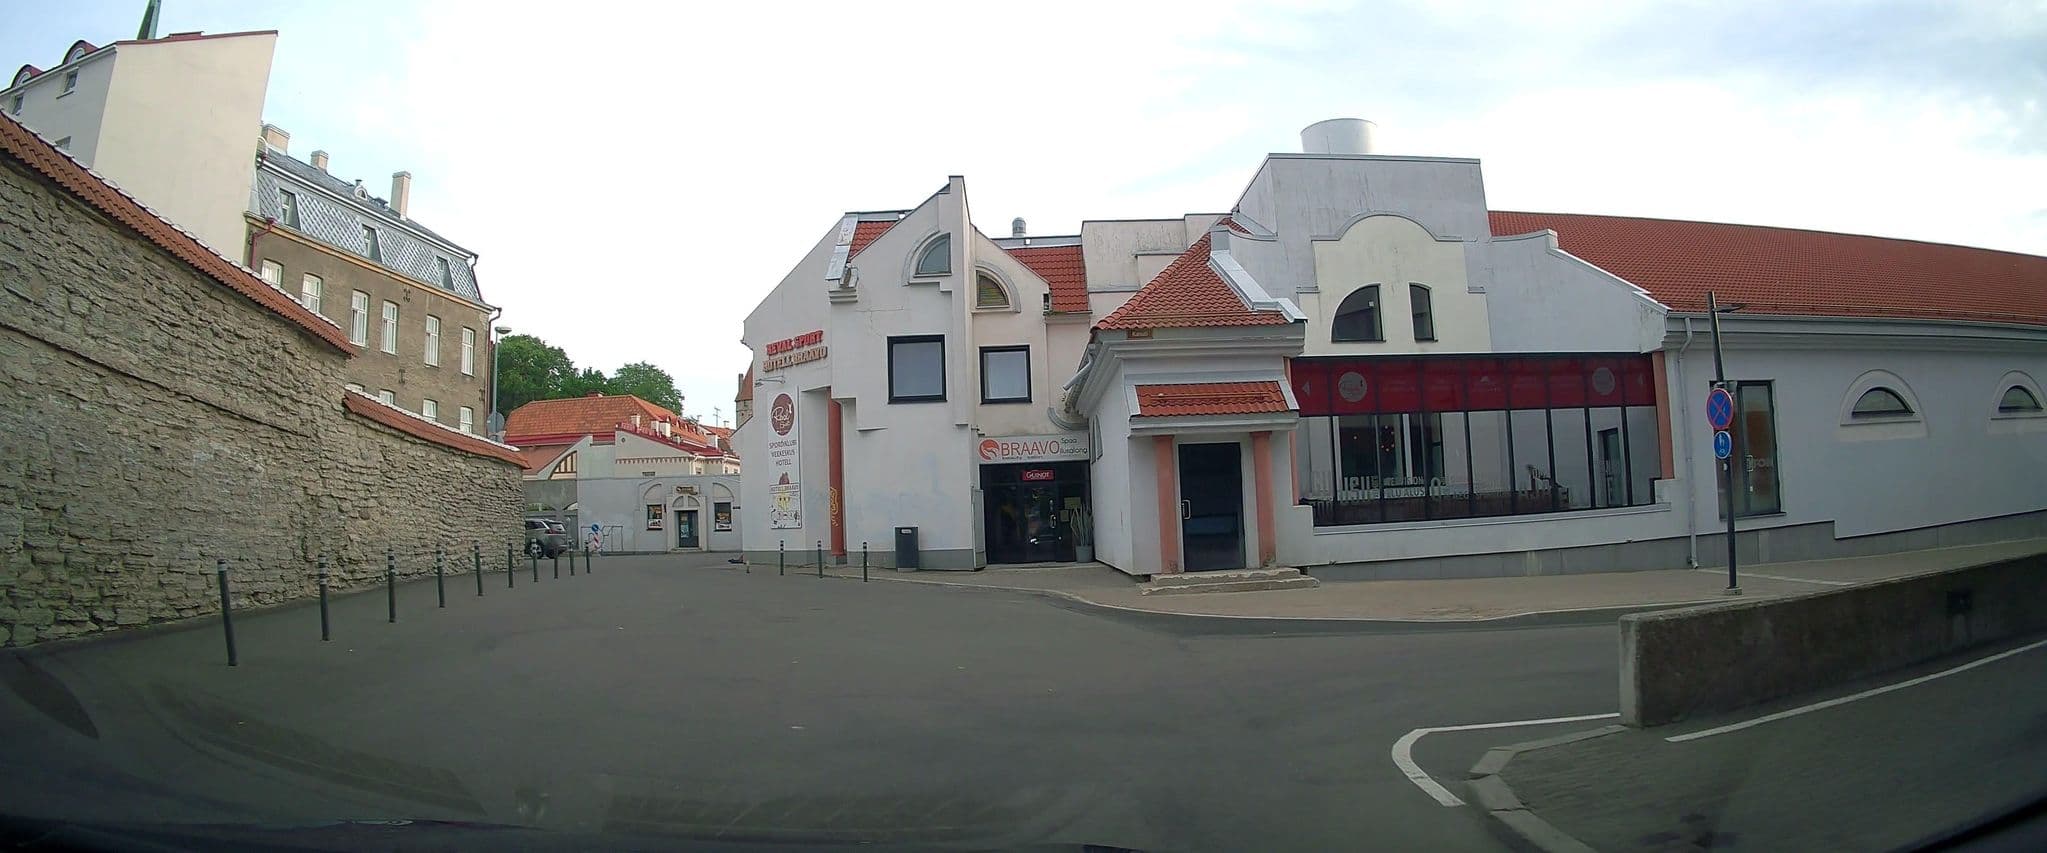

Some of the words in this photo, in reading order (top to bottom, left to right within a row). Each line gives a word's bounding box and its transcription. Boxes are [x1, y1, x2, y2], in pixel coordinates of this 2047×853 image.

[767, 339, 793, 356] REVAL
[794, 330, 823, 349] SPORT
[1001, 441, 1060, 456] BRAAVO
